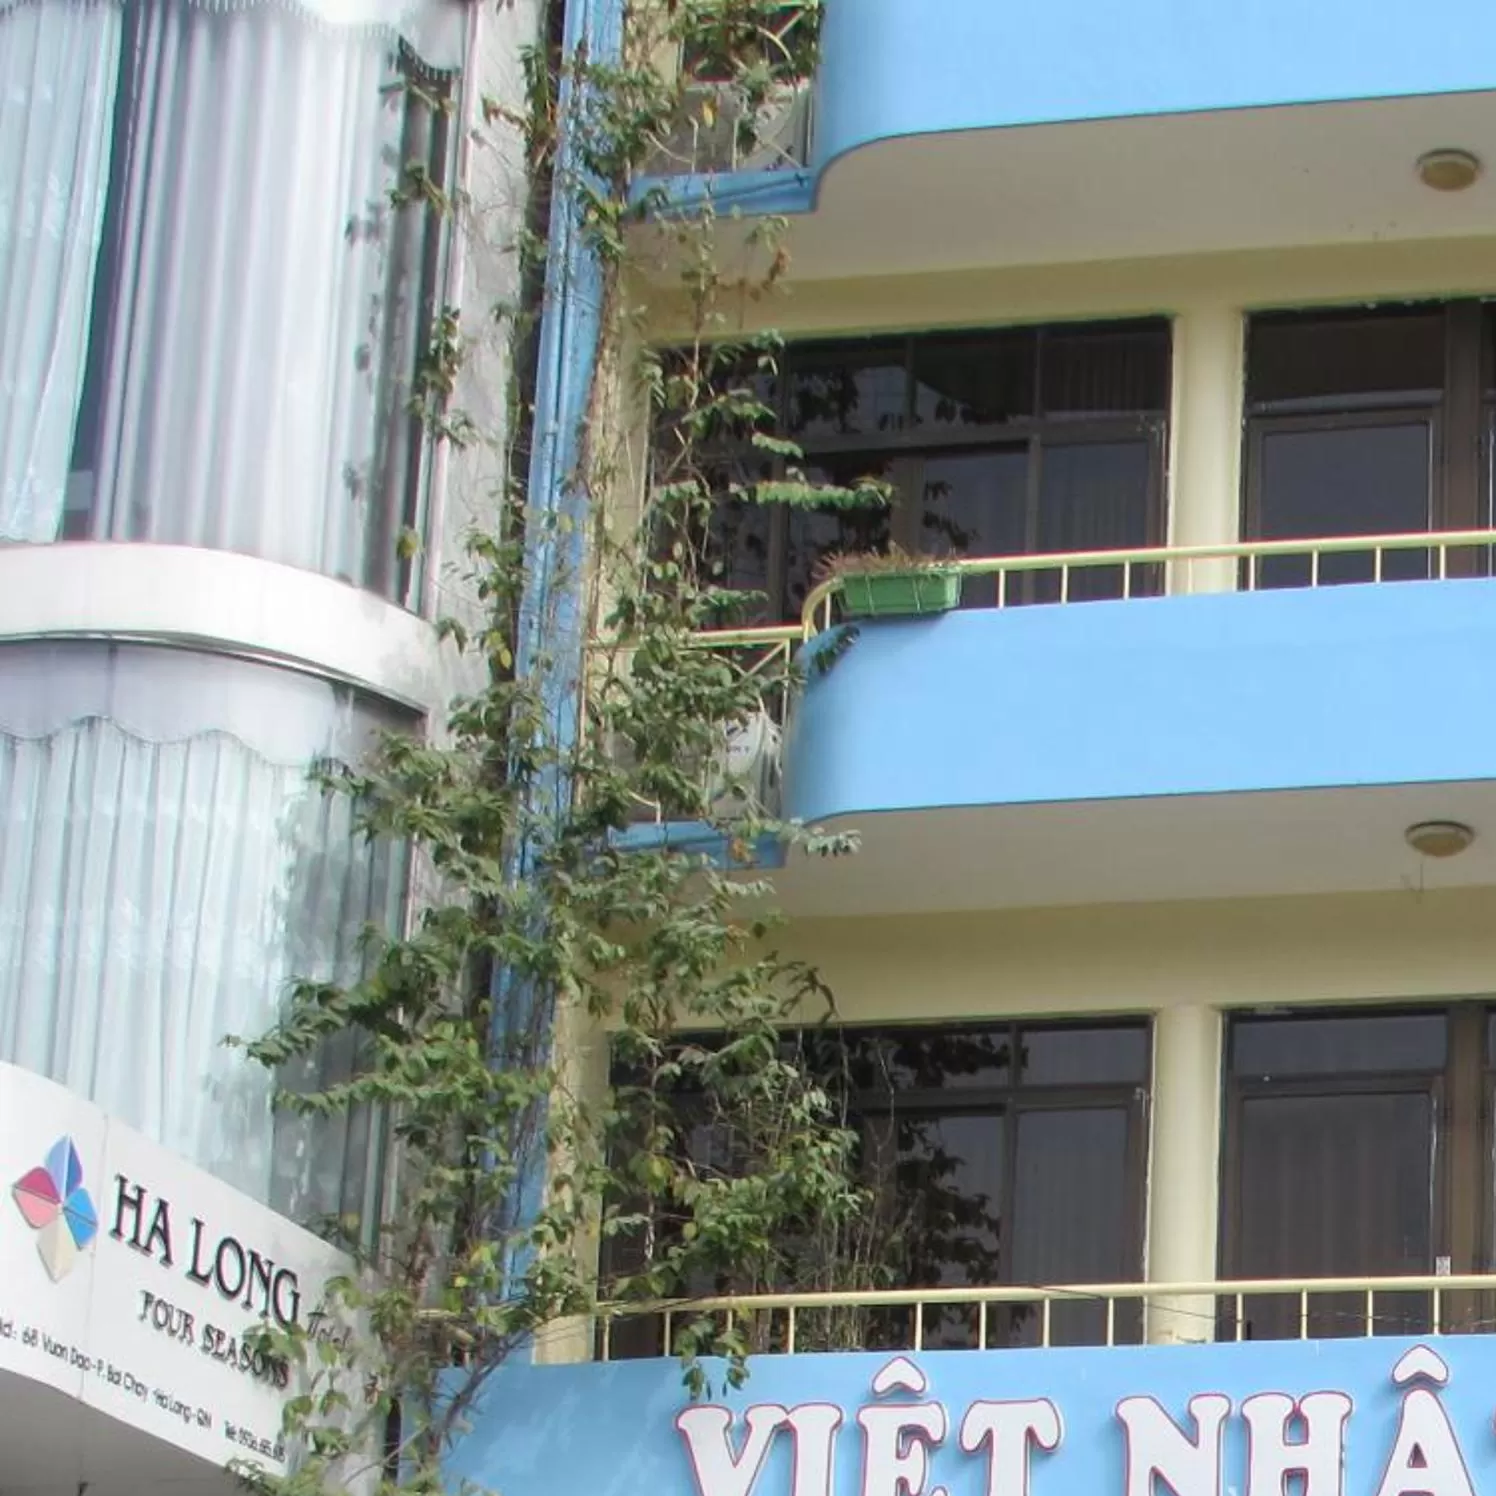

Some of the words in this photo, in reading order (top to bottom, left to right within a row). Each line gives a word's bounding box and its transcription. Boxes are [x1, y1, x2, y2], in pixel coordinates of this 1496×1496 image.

[109, 1173, 174, 1270] HA
[185, 1217, 300, 1328] LONG
[137, 1289, 195, 1346] FOUR
